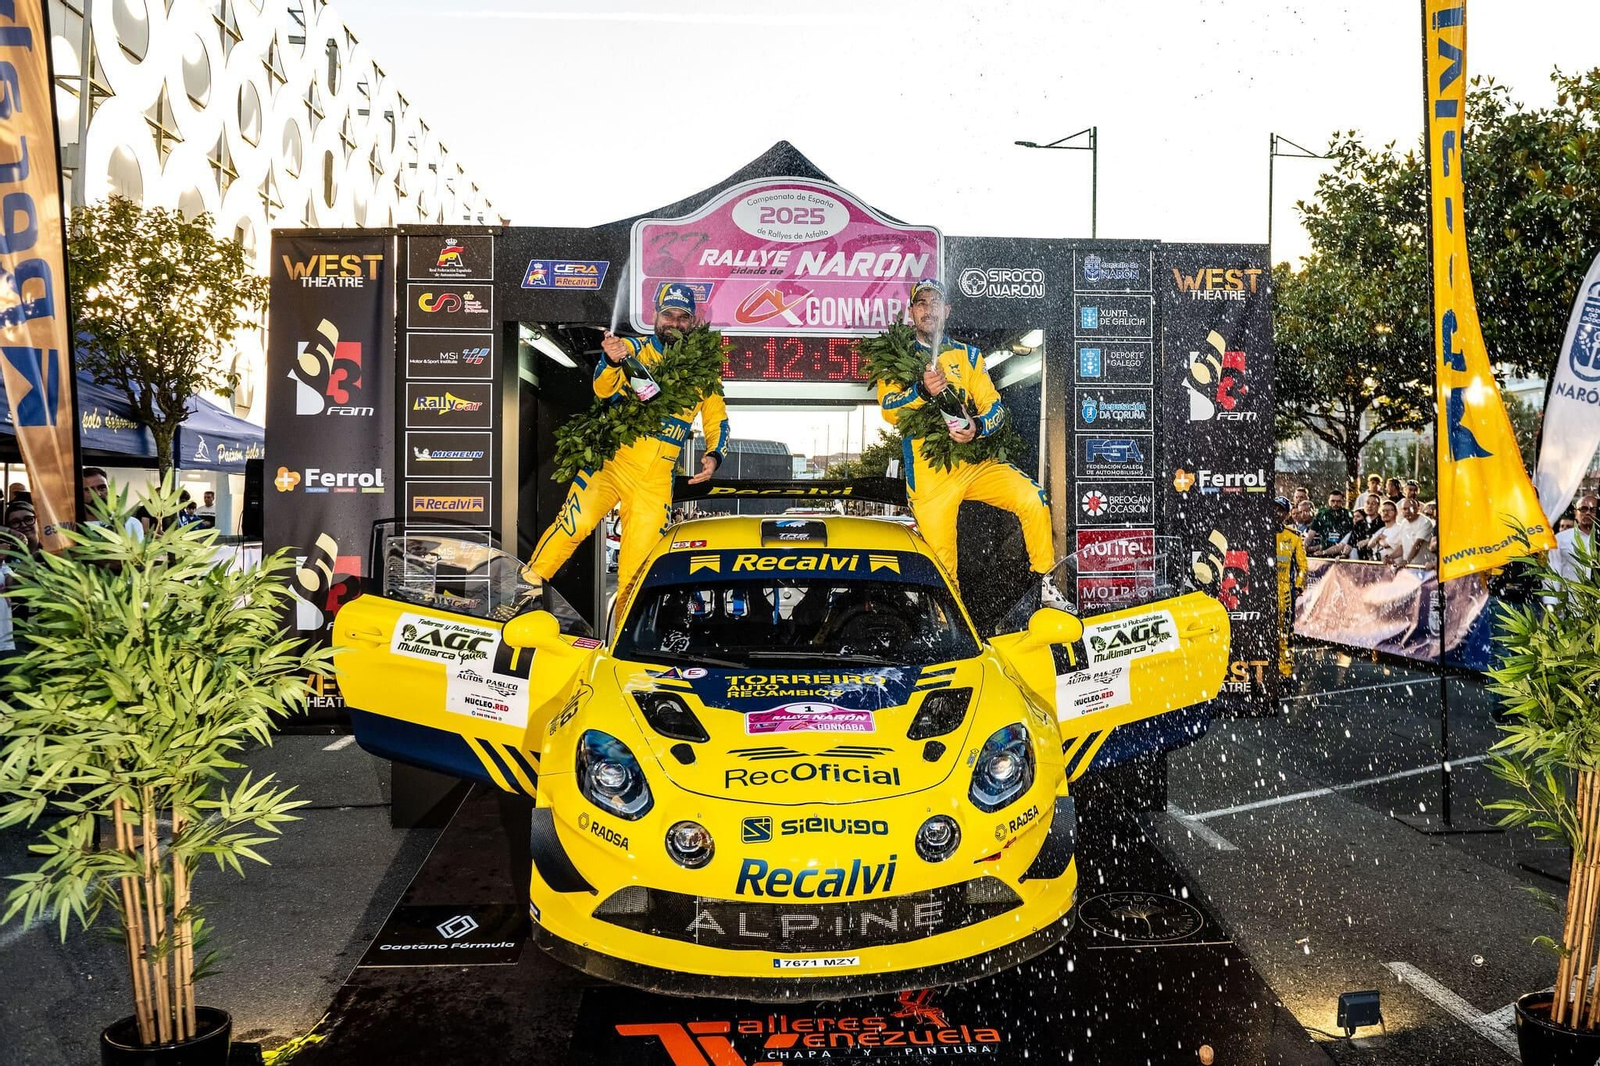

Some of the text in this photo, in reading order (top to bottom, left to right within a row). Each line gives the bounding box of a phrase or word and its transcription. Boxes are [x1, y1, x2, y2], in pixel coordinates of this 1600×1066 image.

[746, 193, 834, 209] Campeonato de España
[760, 206, 825, 225] 2025
[757, 227, 829, 240] de Rallyes de Asfalto
[282, 255, 383, 280] WEST
[554, 264, 598, 273] CERA
[699, 246, 930, 278] RALLYE NARÓN
[730, 266, 783, 275] cidade de
[989, 270, 1042, 283] SIROCO
[1101, 268, 1140, 280] NARÓN
[300, 277, 363, 288] THEATRE
[562, 278, 589, 286] Recalvi
[1172, 268, 1262, 293] WEST
[989, 282, 1043, 296] NARÓN
[1190, 290, 1246, 300] THEATRE
[1101, 309, 1128, 317] XUNTA
[1112, 317, 1146, 326] GALICIA
[1111, 351, 1144, 359] DEPORTE
[1556, 382, 1600, 406] NARÓ
[326, 406, 374, 416] fam
[1100, 411, 1111, 419] DA
[1217, 411, 1257, 421] fam
[431, 450, 484, 458] MICHELIN
[305, 468, 384, 487] Ferrol
[1199, 469, 1266, 487] Ferrol
[426, 499, 471, 510] Recalvi
[732, 553, 860, 572] Recalvi
[418, 618, 444, 629] Talleres
[451, 624, 494, 637] Automóviles
[1096, 624, 1121, 633] Talleres
[415, 629, 494, 652] AGC
[1107, 619, 1168, 650] AGC
[397, 642, 456, 660] Multimarca
[1093, 644, 1147, 663] Multimarca
[456, 673, 484, 685] AUTOS
[725, 674, 886, 685] TORREIRO
[1230, 661, 1269, 685] ST
[727, 689, 844, 699] RECAMBIOS
[1219, 682, 1251, 693] ATRE
[465, 696, 509, 712] NUCLEO.RED
[812, 713, 868, 721] NARÓN
[817, 723, 865, 731] GONNABA
[725, 763, 900, 788] RecOficial
[1009, 805, 1039, 833] RADSA
[590, 821, 629, 851] RADSA
[735, 854, 897, 898] Recalvi
[686, 901, 944, 938] ALPINE
[451, 942, 515, 950] Fórmula
[783, 958, 856, 967] 7671 MZY
[768, 1050, 831, 1060] CHAPA
[905, 1045, 992, 1056] PINTURA
